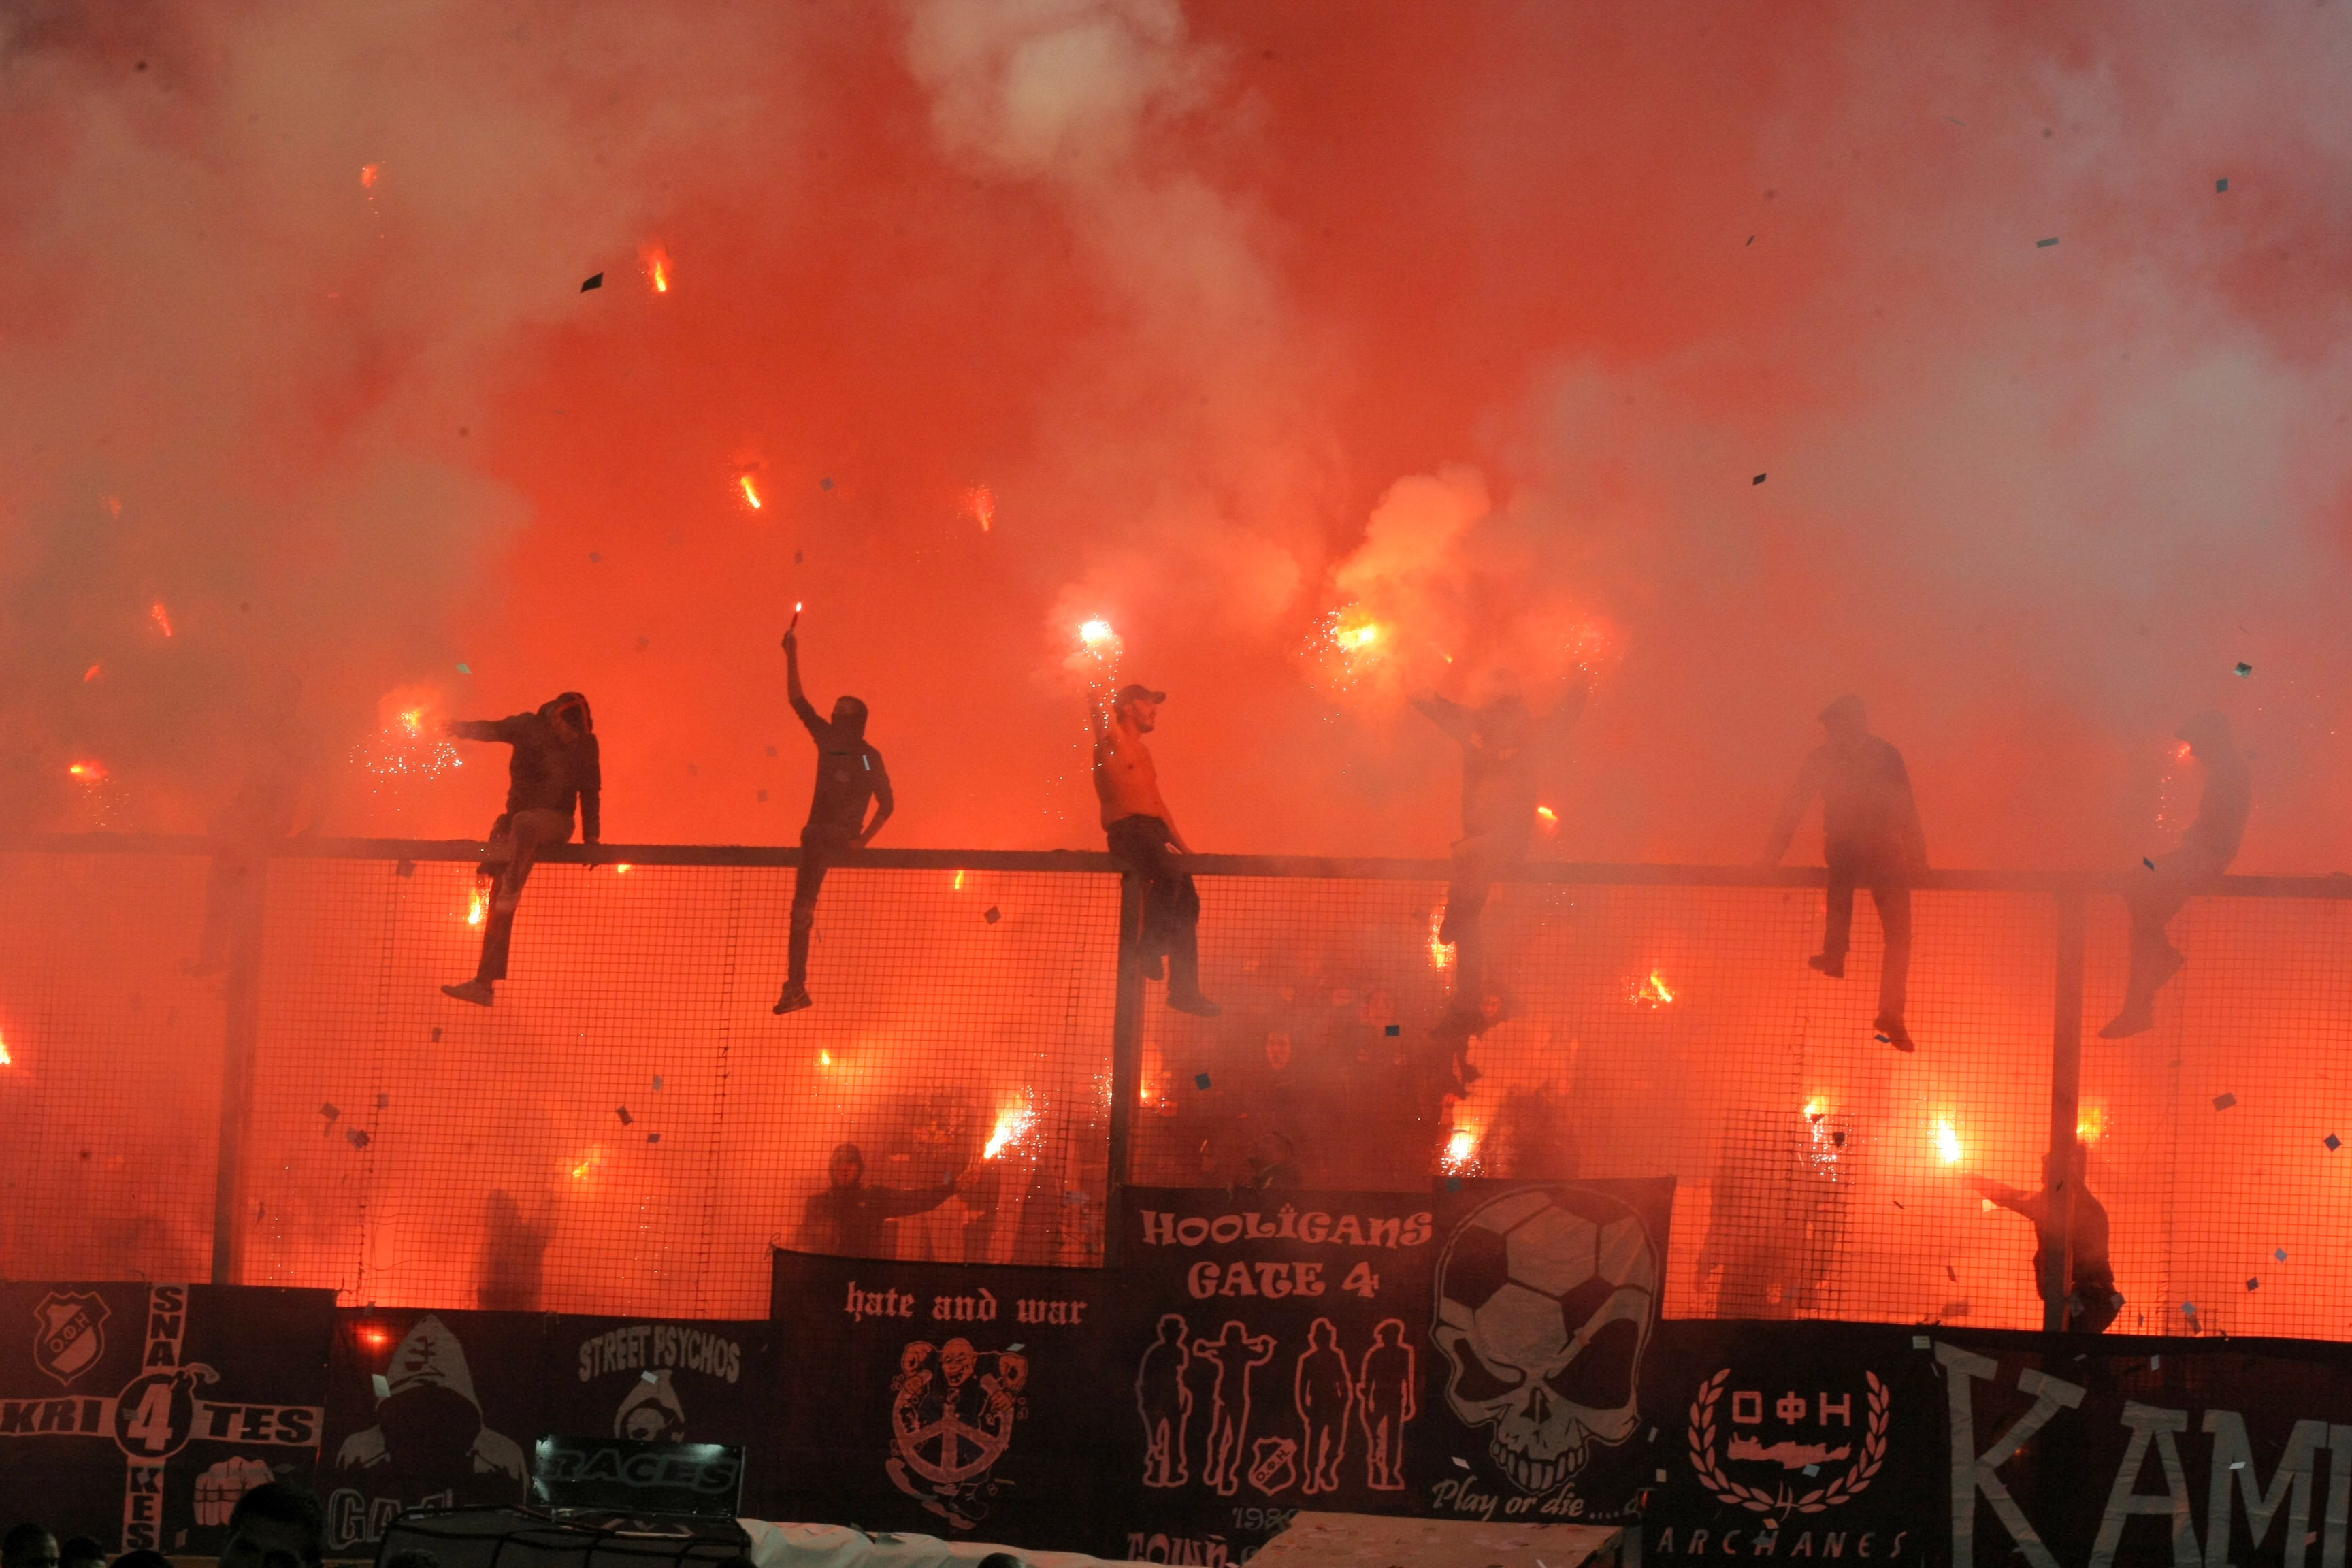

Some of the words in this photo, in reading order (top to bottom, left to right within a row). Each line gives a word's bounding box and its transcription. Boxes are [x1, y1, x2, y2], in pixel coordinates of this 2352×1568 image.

[1187, 1261, 1326, 1298] GATE
[1341, 1262, 1380, 1297] 4
[845, 1281, 915, 1322] hate
[932, 1288, 998, 1321] and
[1016, 1298, 1088, 1325] war
[578, 1326, 651, 1382] STREET
[654, 1326, 741, 1384] PSYCHOS
[1431, 1475, 1499, 1522] Play
[1505, 1495, 1538, 1514] or
[1656, 1526, 1907, 1558] ARCHANES
